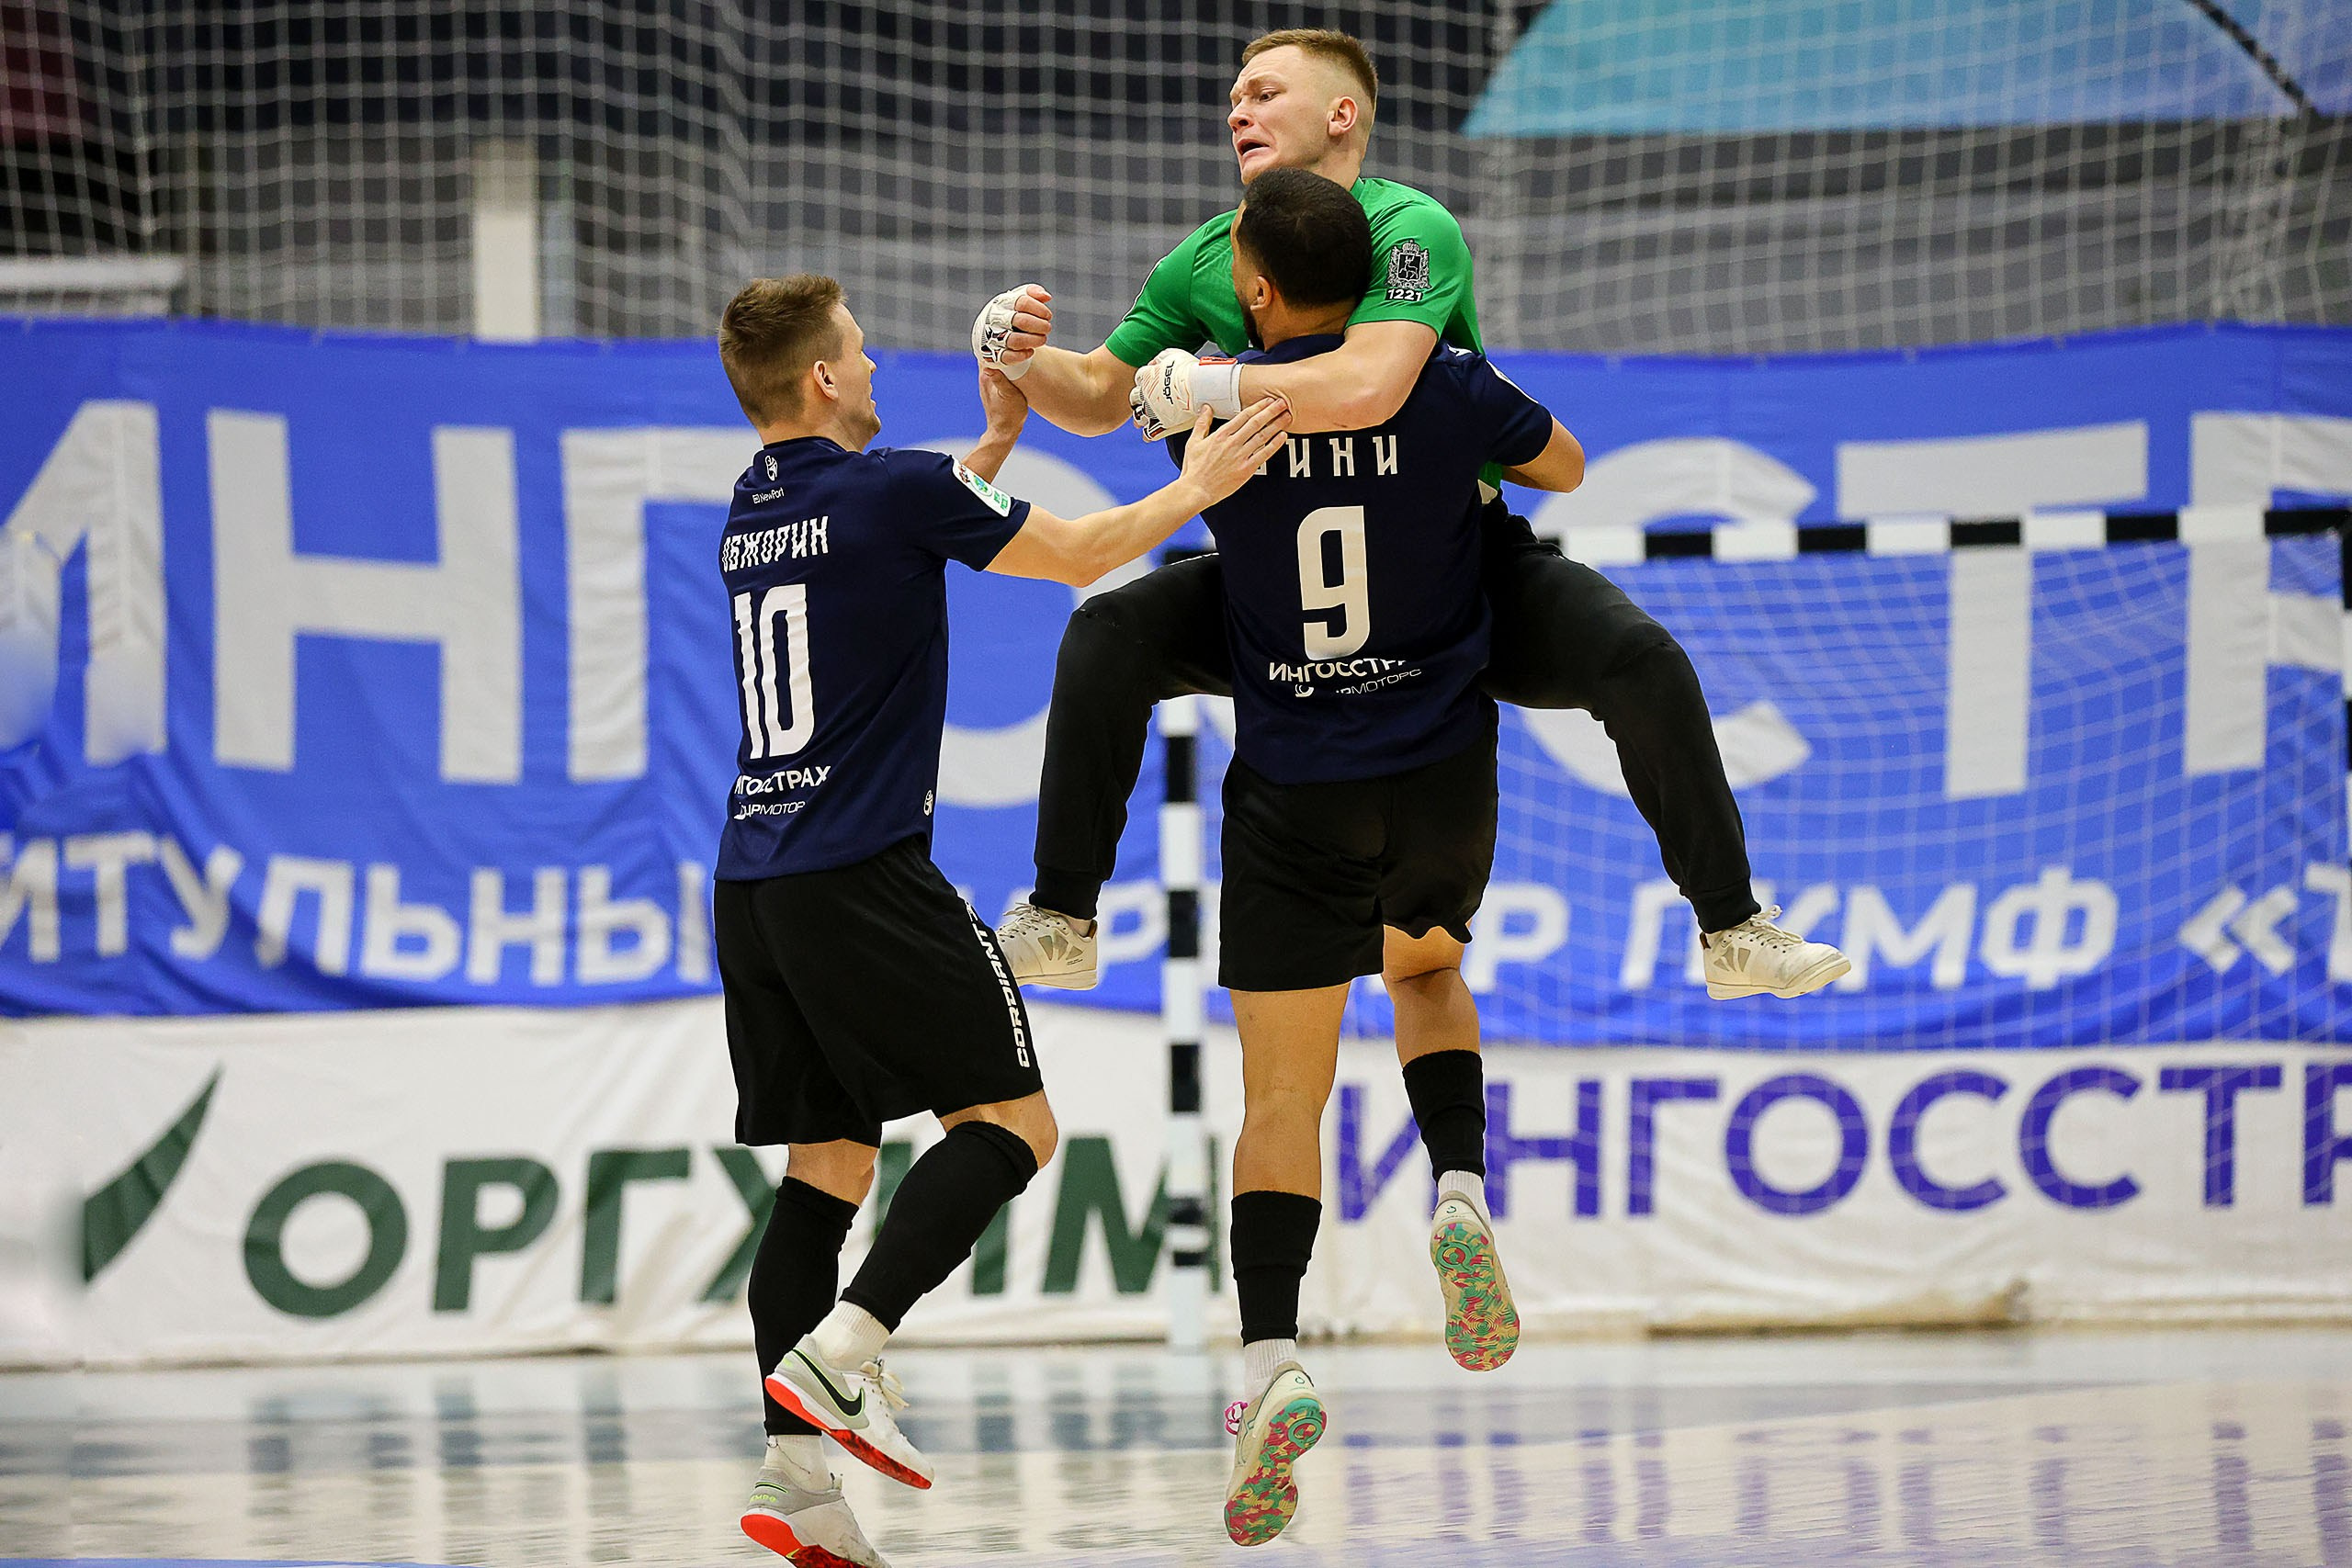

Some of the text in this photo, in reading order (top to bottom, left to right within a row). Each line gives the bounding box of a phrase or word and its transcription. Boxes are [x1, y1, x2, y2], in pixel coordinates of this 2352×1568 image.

[1387, 288, 1422, 301] 1221
[1163, 360, 1175, 404] JÖGEL
[1254, 435, 1397, 478] ИНИ
[721, 515, 829, 572] ОБЖОРИН
[1296, 505, 1370, 660] 9
[735, 583, 815, 759] 10
